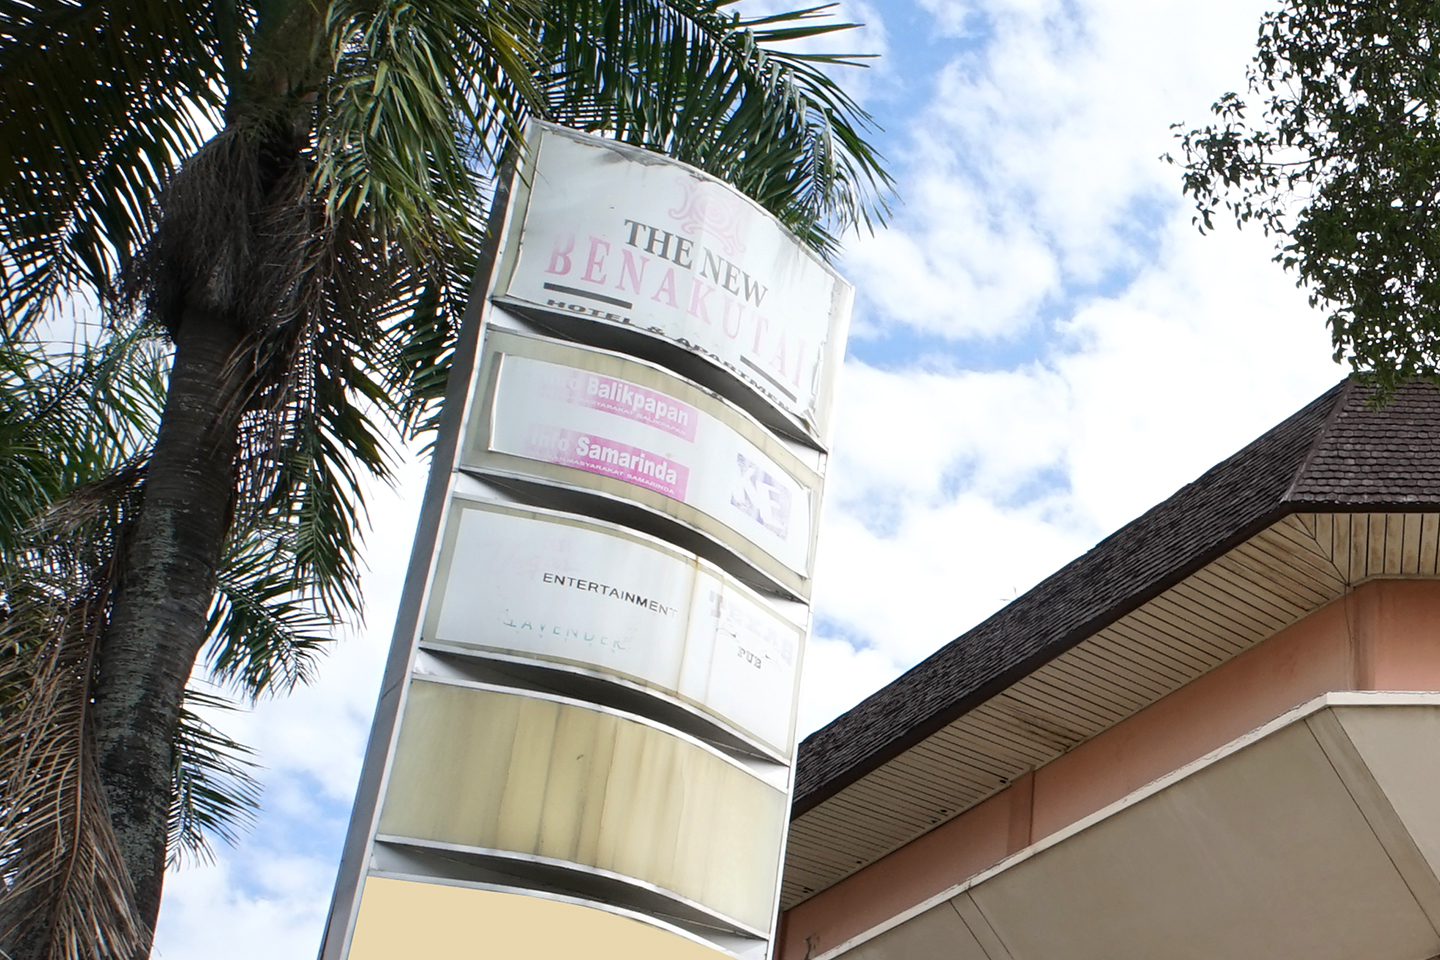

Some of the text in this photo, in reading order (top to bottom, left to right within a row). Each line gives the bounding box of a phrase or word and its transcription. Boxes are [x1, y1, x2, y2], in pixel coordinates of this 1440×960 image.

[624, 219, 768, 308] THE NEW
[545, 232, 807, 389] BENAKUTAI
[547, 299, 632, 325] HOTEL
[586, 374, 689, 426] Balikpapan
[576, 436, 677, 485] Samarinda
[627, 474, 674, 495] SAMARINDA
[542, 572, 678, 616] ENTERTAINMENT
[738, 646, 762, 670] PUB
